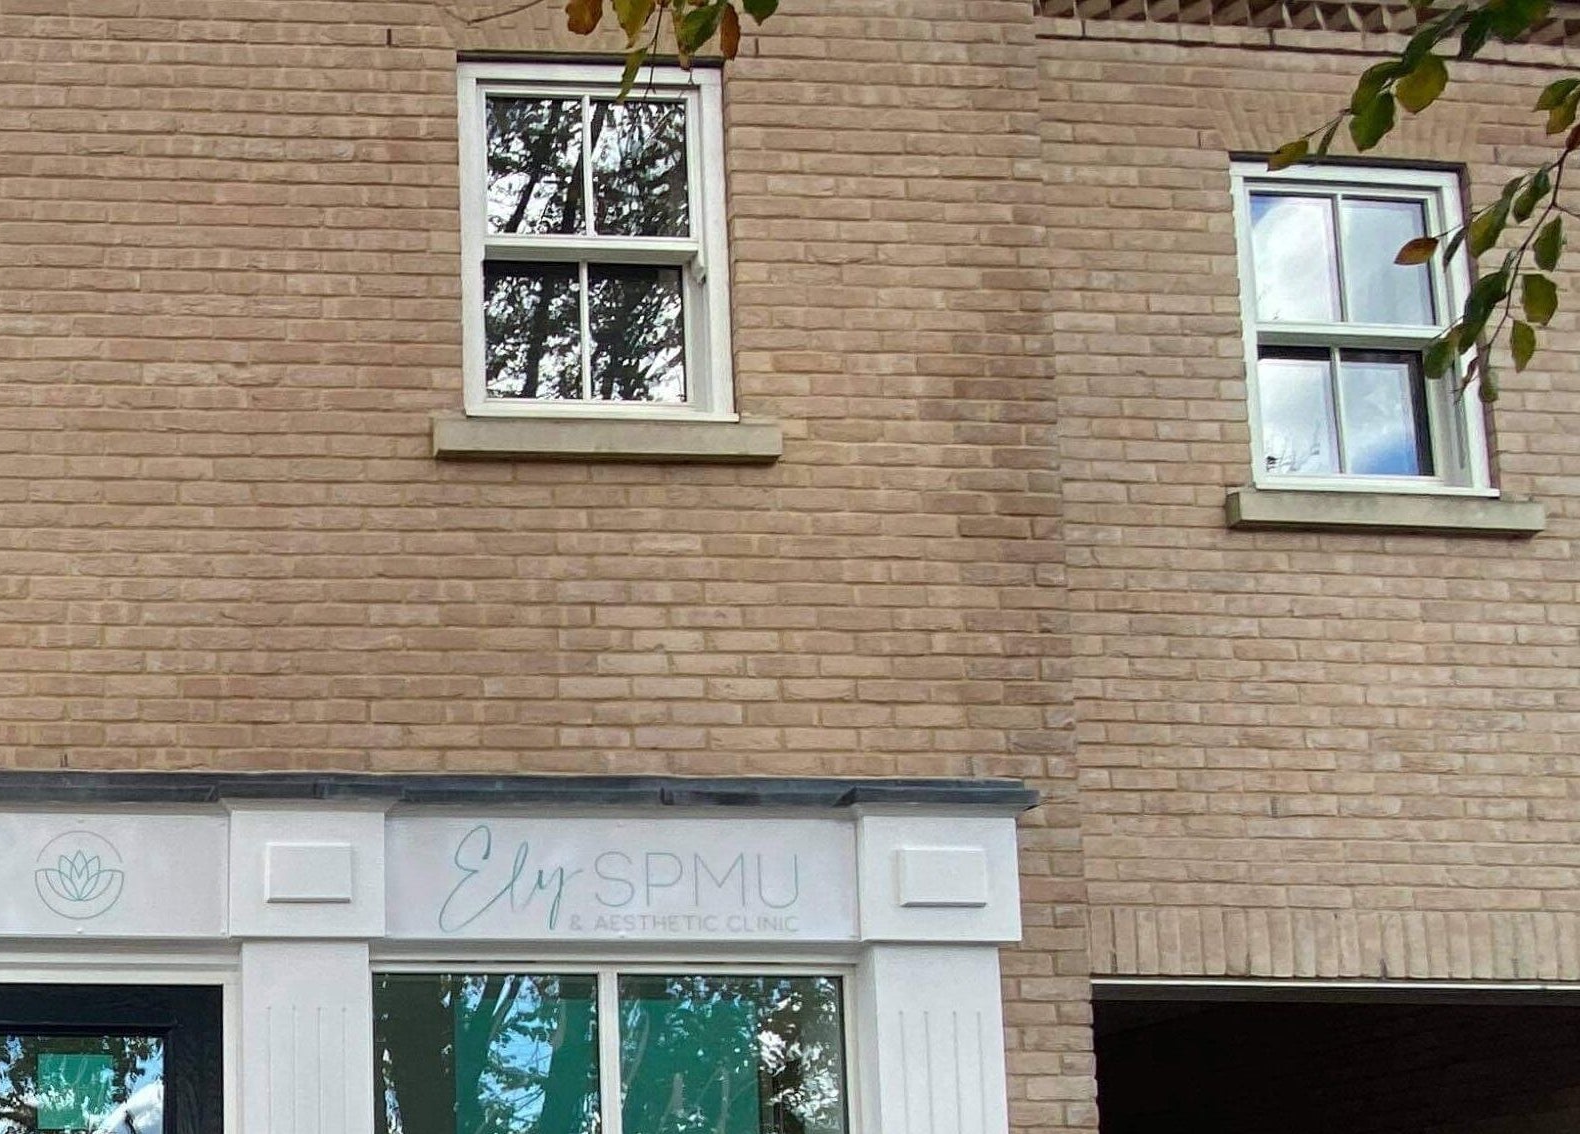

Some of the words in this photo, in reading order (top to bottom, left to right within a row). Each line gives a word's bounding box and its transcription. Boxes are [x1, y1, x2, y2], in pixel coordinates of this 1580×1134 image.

[438, 825, 585, 933] Ely
[594, 851, 800, 911] SPMU
[568, 916, 583, 931] &
[593, 915, 719, 932] AESTHETIC
[726, 915, 800, 933] CLINIC
